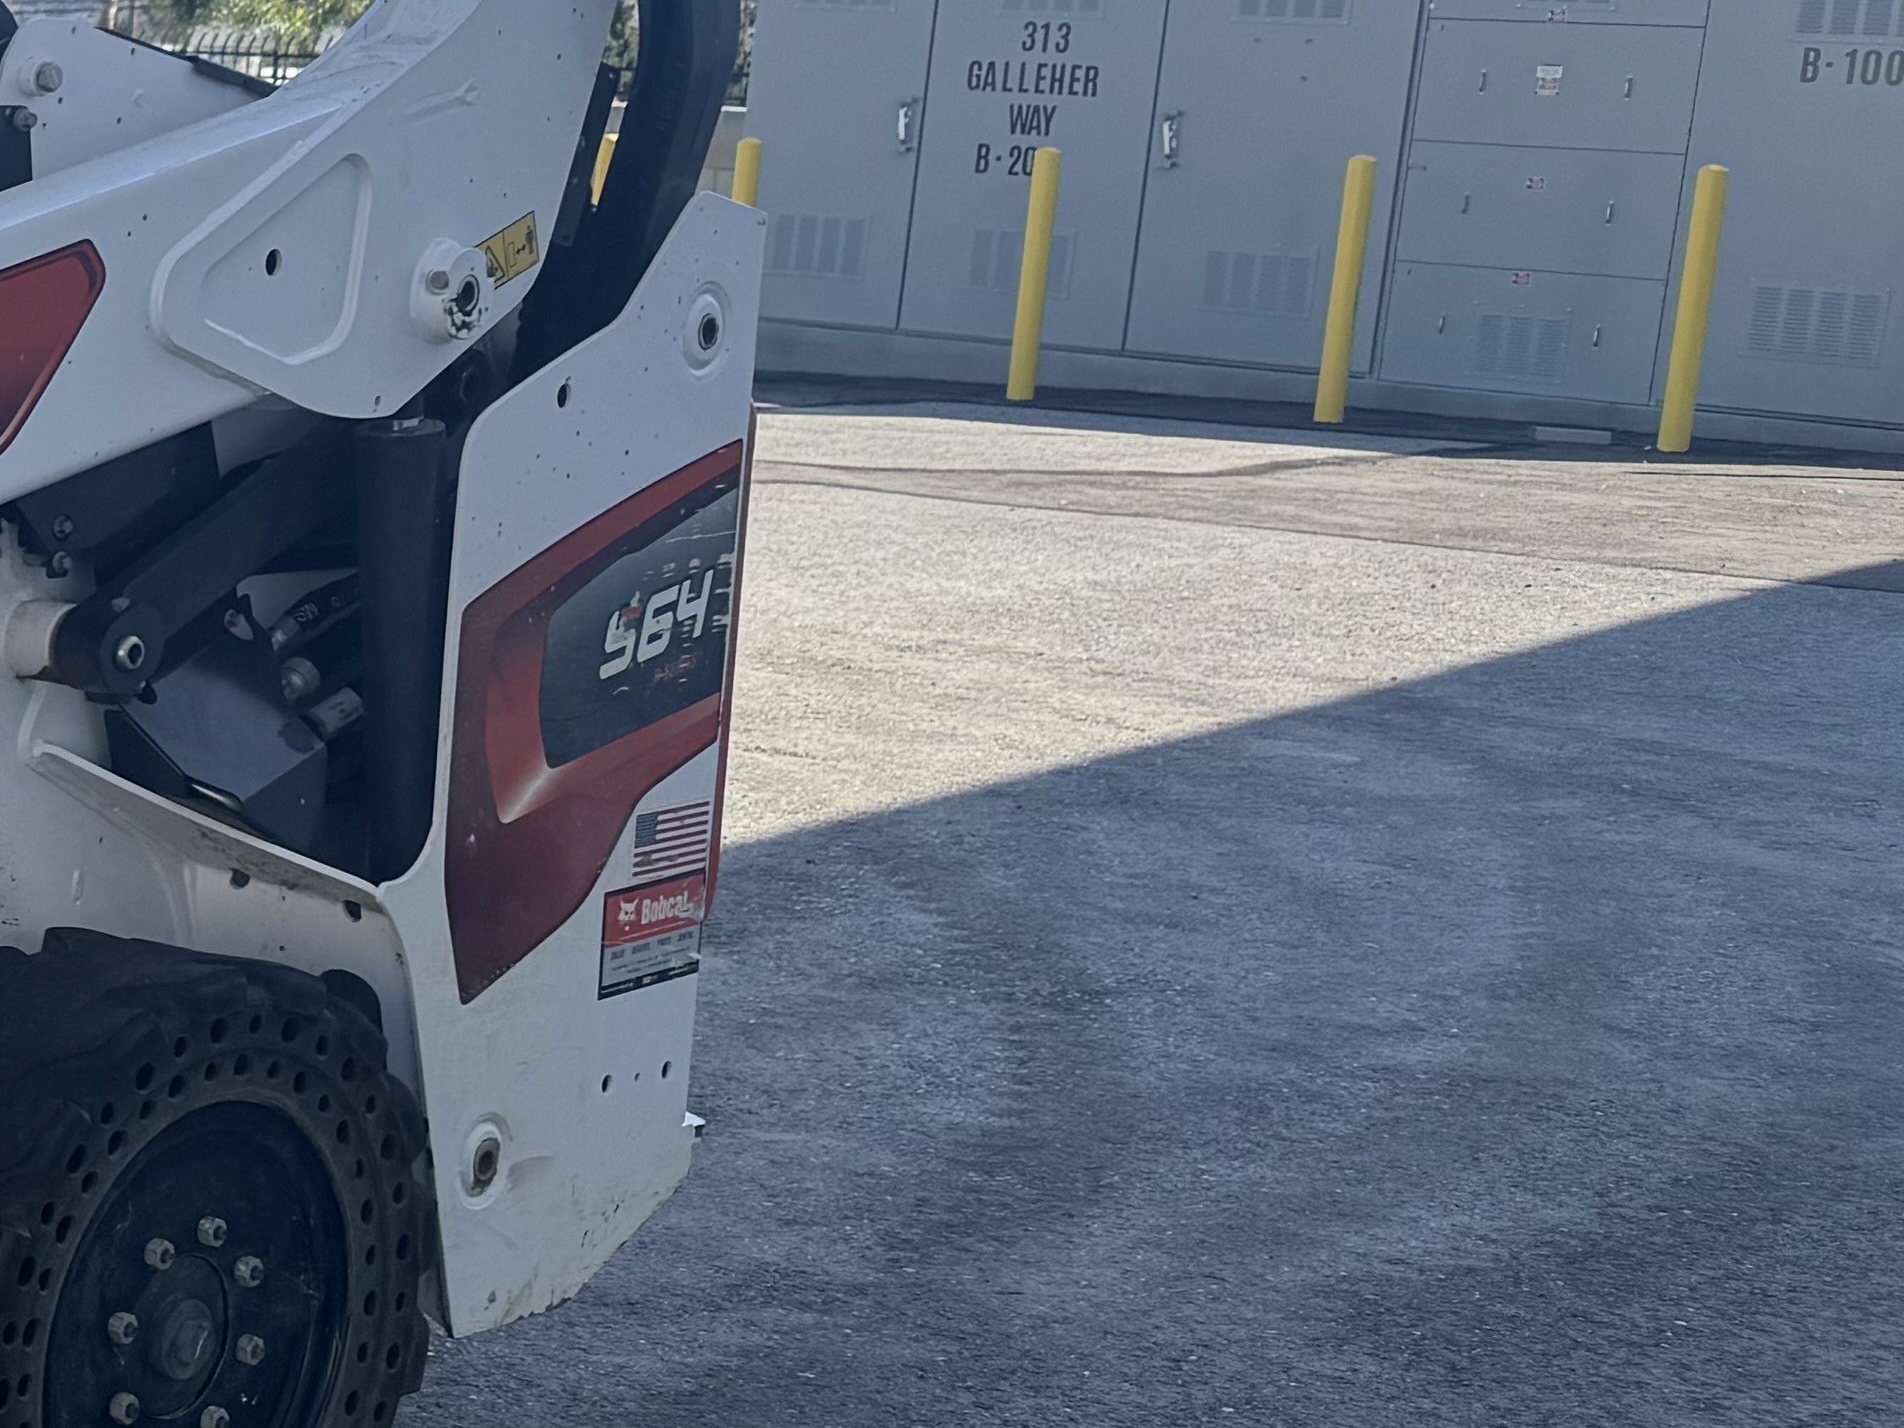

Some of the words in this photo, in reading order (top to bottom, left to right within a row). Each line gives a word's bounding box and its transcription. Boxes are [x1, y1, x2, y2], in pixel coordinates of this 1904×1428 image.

[1021, 20, 1072, 54] 313
[967, 60, 1100, 97] GALLEHER
[1009, 103, 1057, 137] WAY
[599, 569, 714, 680] S64
